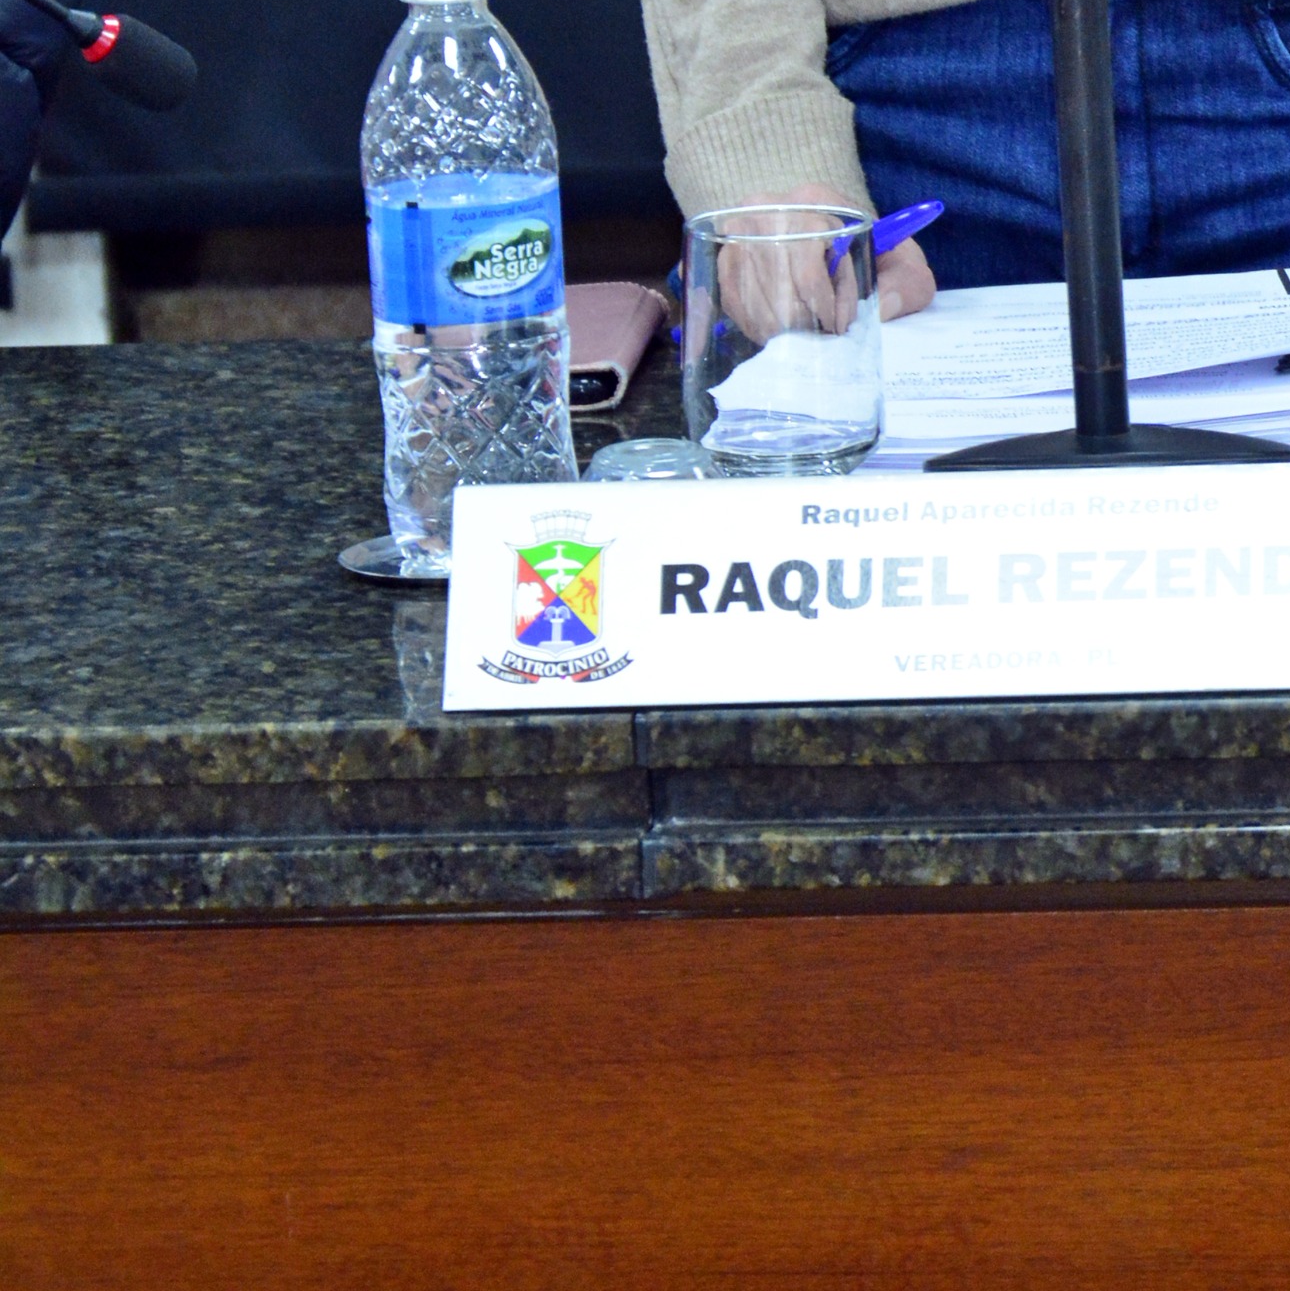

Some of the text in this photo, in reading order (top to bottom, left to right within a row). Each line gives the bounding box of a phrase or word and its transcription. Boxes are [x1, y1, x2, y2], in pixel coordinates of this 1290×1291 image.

[489, 240, 544, 263] Serra
[473, 256, 538, 280] Negra
[800, 491, 1220, 527] Raquel Aparecida Rezende
[658, 556, 969, 620] RAQUEL
[893, 649, 1063, 673] VEREADORA
